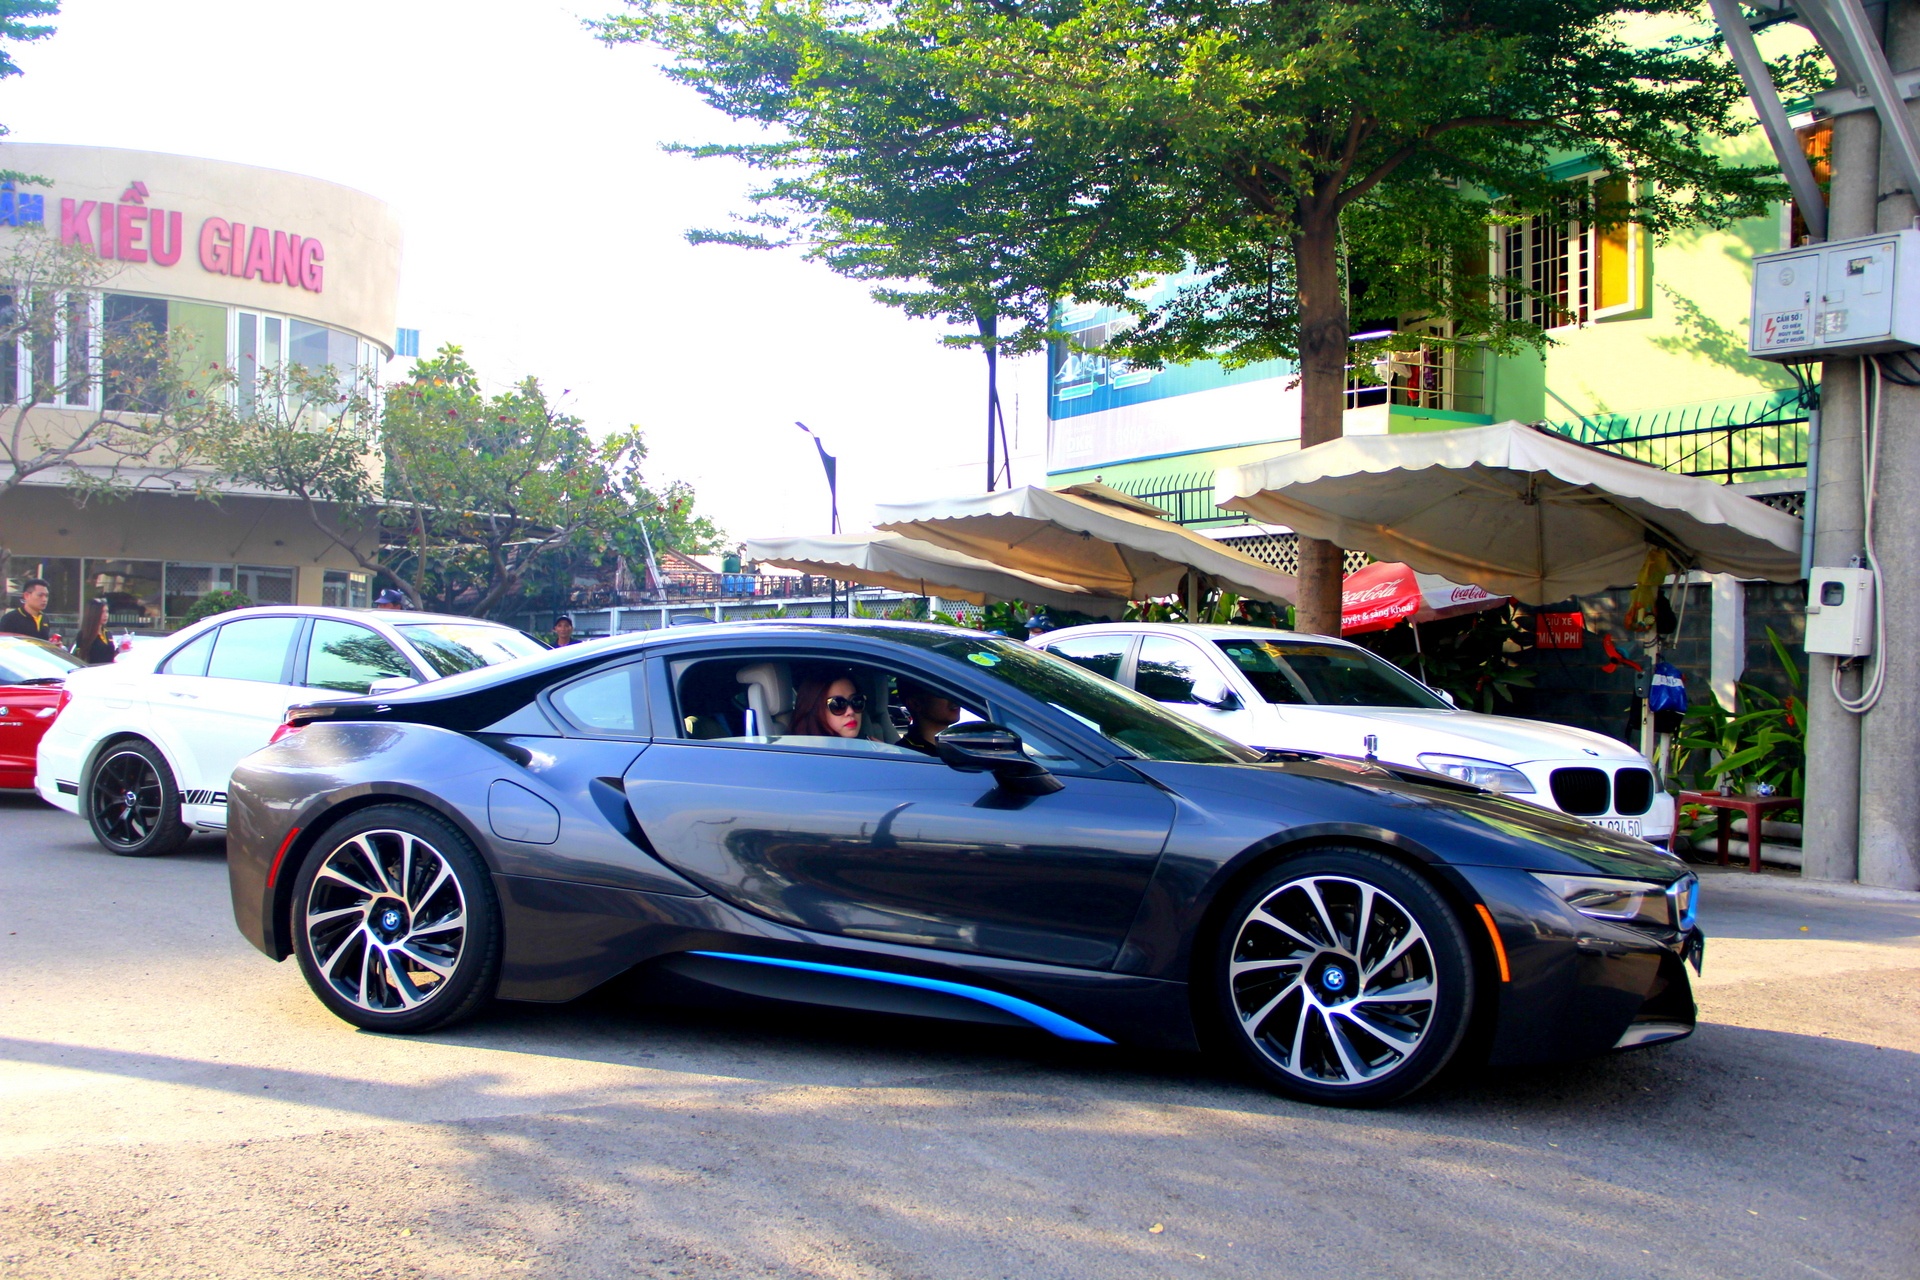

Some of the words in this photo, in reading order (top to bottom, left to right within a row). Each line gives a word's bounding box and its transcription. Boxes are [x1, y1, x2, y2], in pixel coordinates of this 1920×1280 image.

[61, 180, 183, 268] KIỀU
[198, 216, 325, 294] GIANG
[1342, 578, 1405, 605] oca-Cola
[1451, 585, 1488, 602] Coca-Cola
[1341, 614, 1361, 624] uyệt
[1362, 611, 1369, 620] &
[1561, 617, 1573, 626] XE
